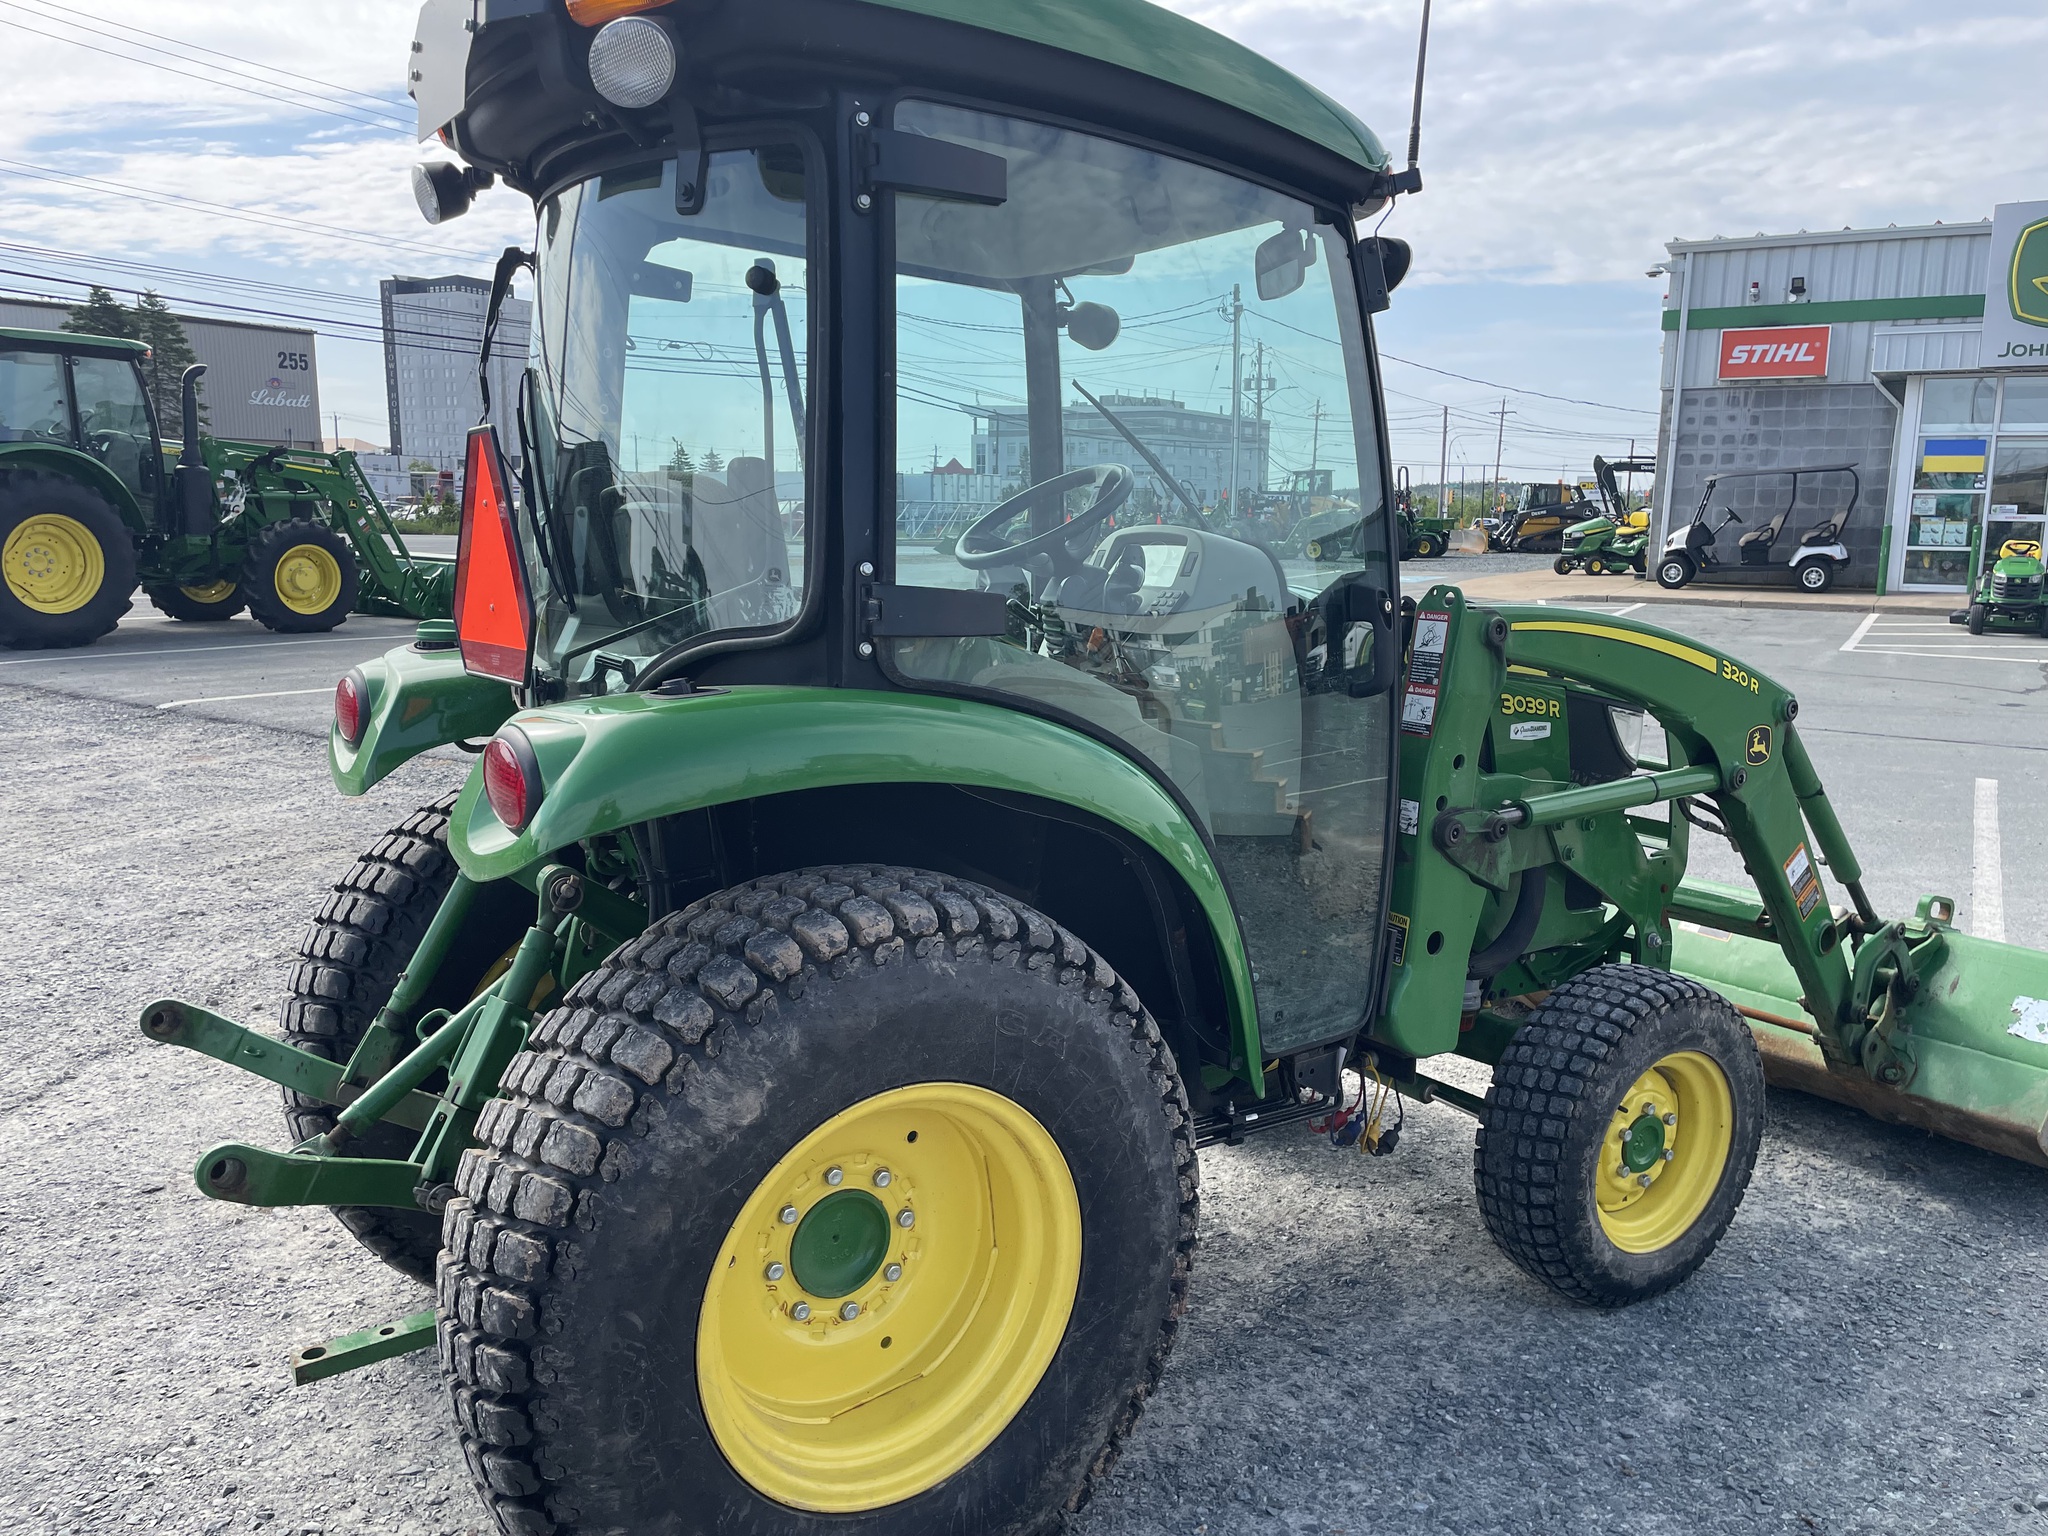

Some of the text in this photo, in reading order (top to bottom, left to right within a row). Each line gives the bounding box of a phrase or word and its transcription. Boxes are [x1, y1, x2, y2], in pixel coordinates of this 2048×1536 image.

[1727, 342, 1815, 364] STIHL
[1997, 341, 2048, 358] JOH
[277, 351, 309, 371] 255
[247, 388, 311, 408] Labatt
[1426, 613, 1449, 621] DANGER
[1722, 659, 1759, 695] 320 R
[1414, 686, 1437, 695] DANGER
[1501, 693, 1560, 718] 3039 R
